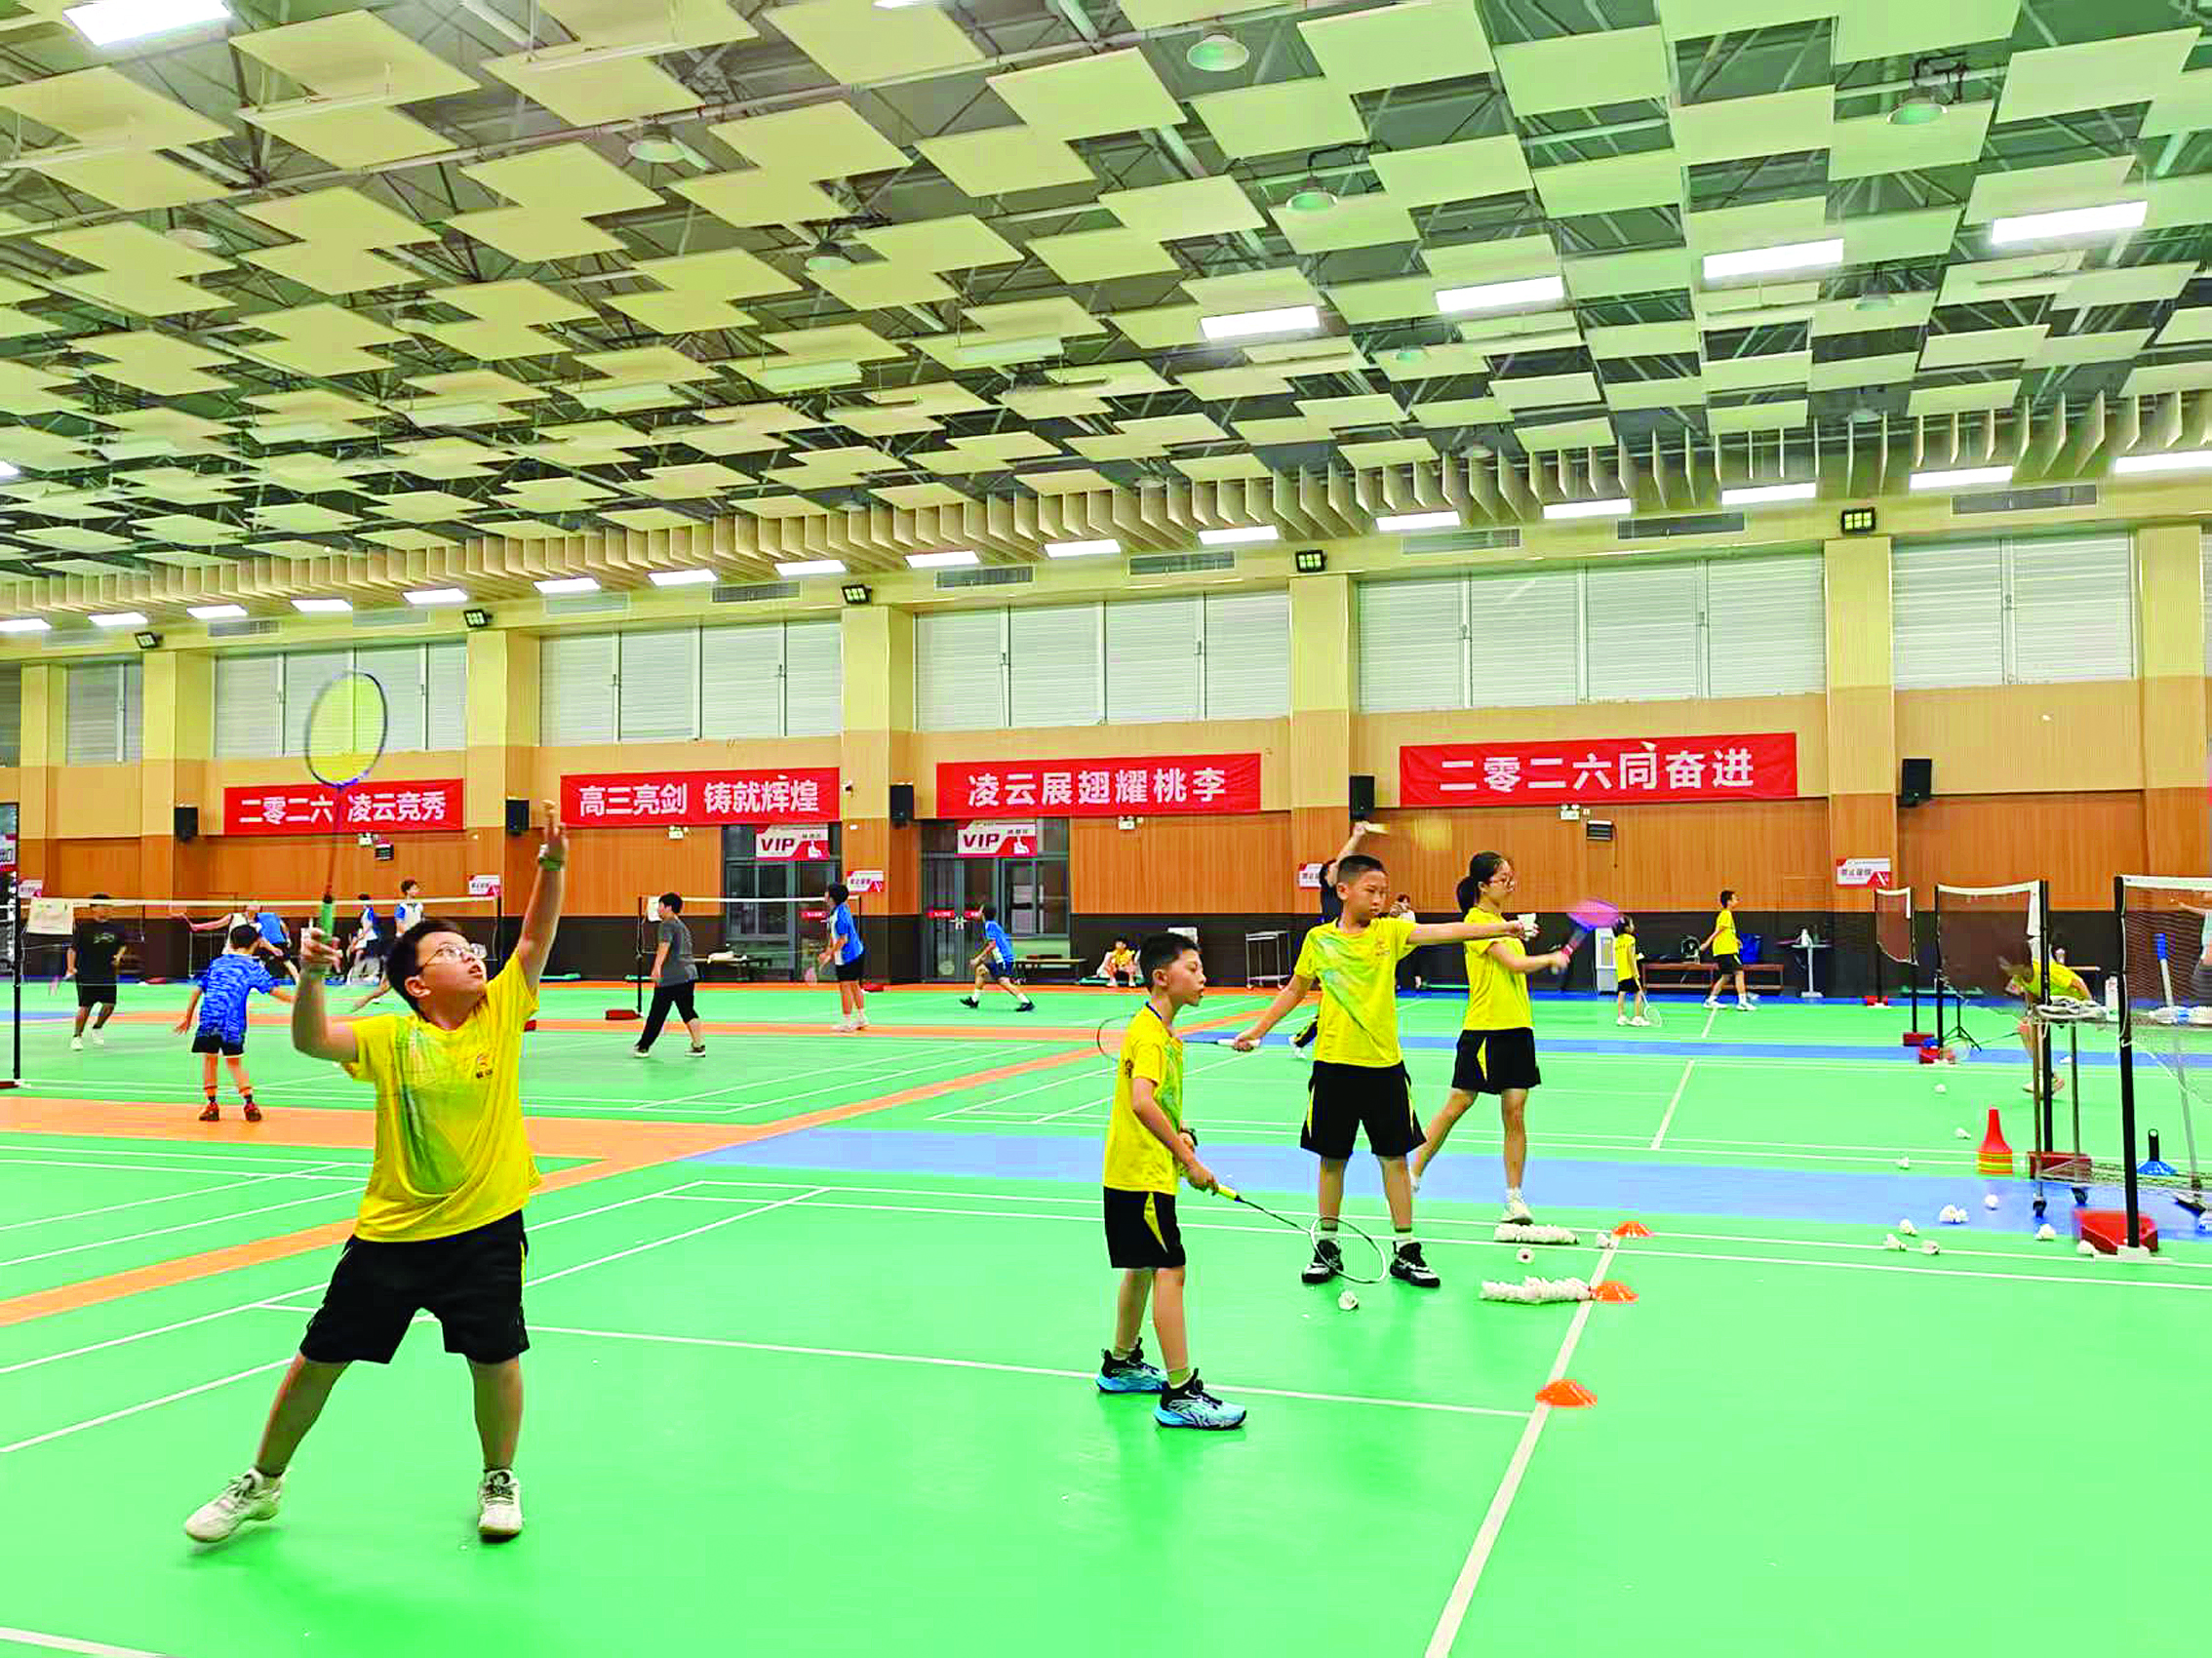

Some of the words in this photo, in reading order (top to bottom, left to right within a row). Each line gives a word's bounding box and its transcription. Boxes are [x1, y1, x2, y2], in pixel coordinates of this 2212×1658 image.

[968, 767, 1225, 807] 凌云展翅耀桃李
[1440, 747, 1754, 792] 二零二六同奋进
[239, 793, 334, 825] 二零二六
[347, 790, 446, 822] 凌云竞秀
[579, 782, 688, 817] 高三亮剑
[704, 779, 819, 813] 铸就辉煌
[760, 838, 795, 851] VIP
[962, 833, 1001, 848] VIP
